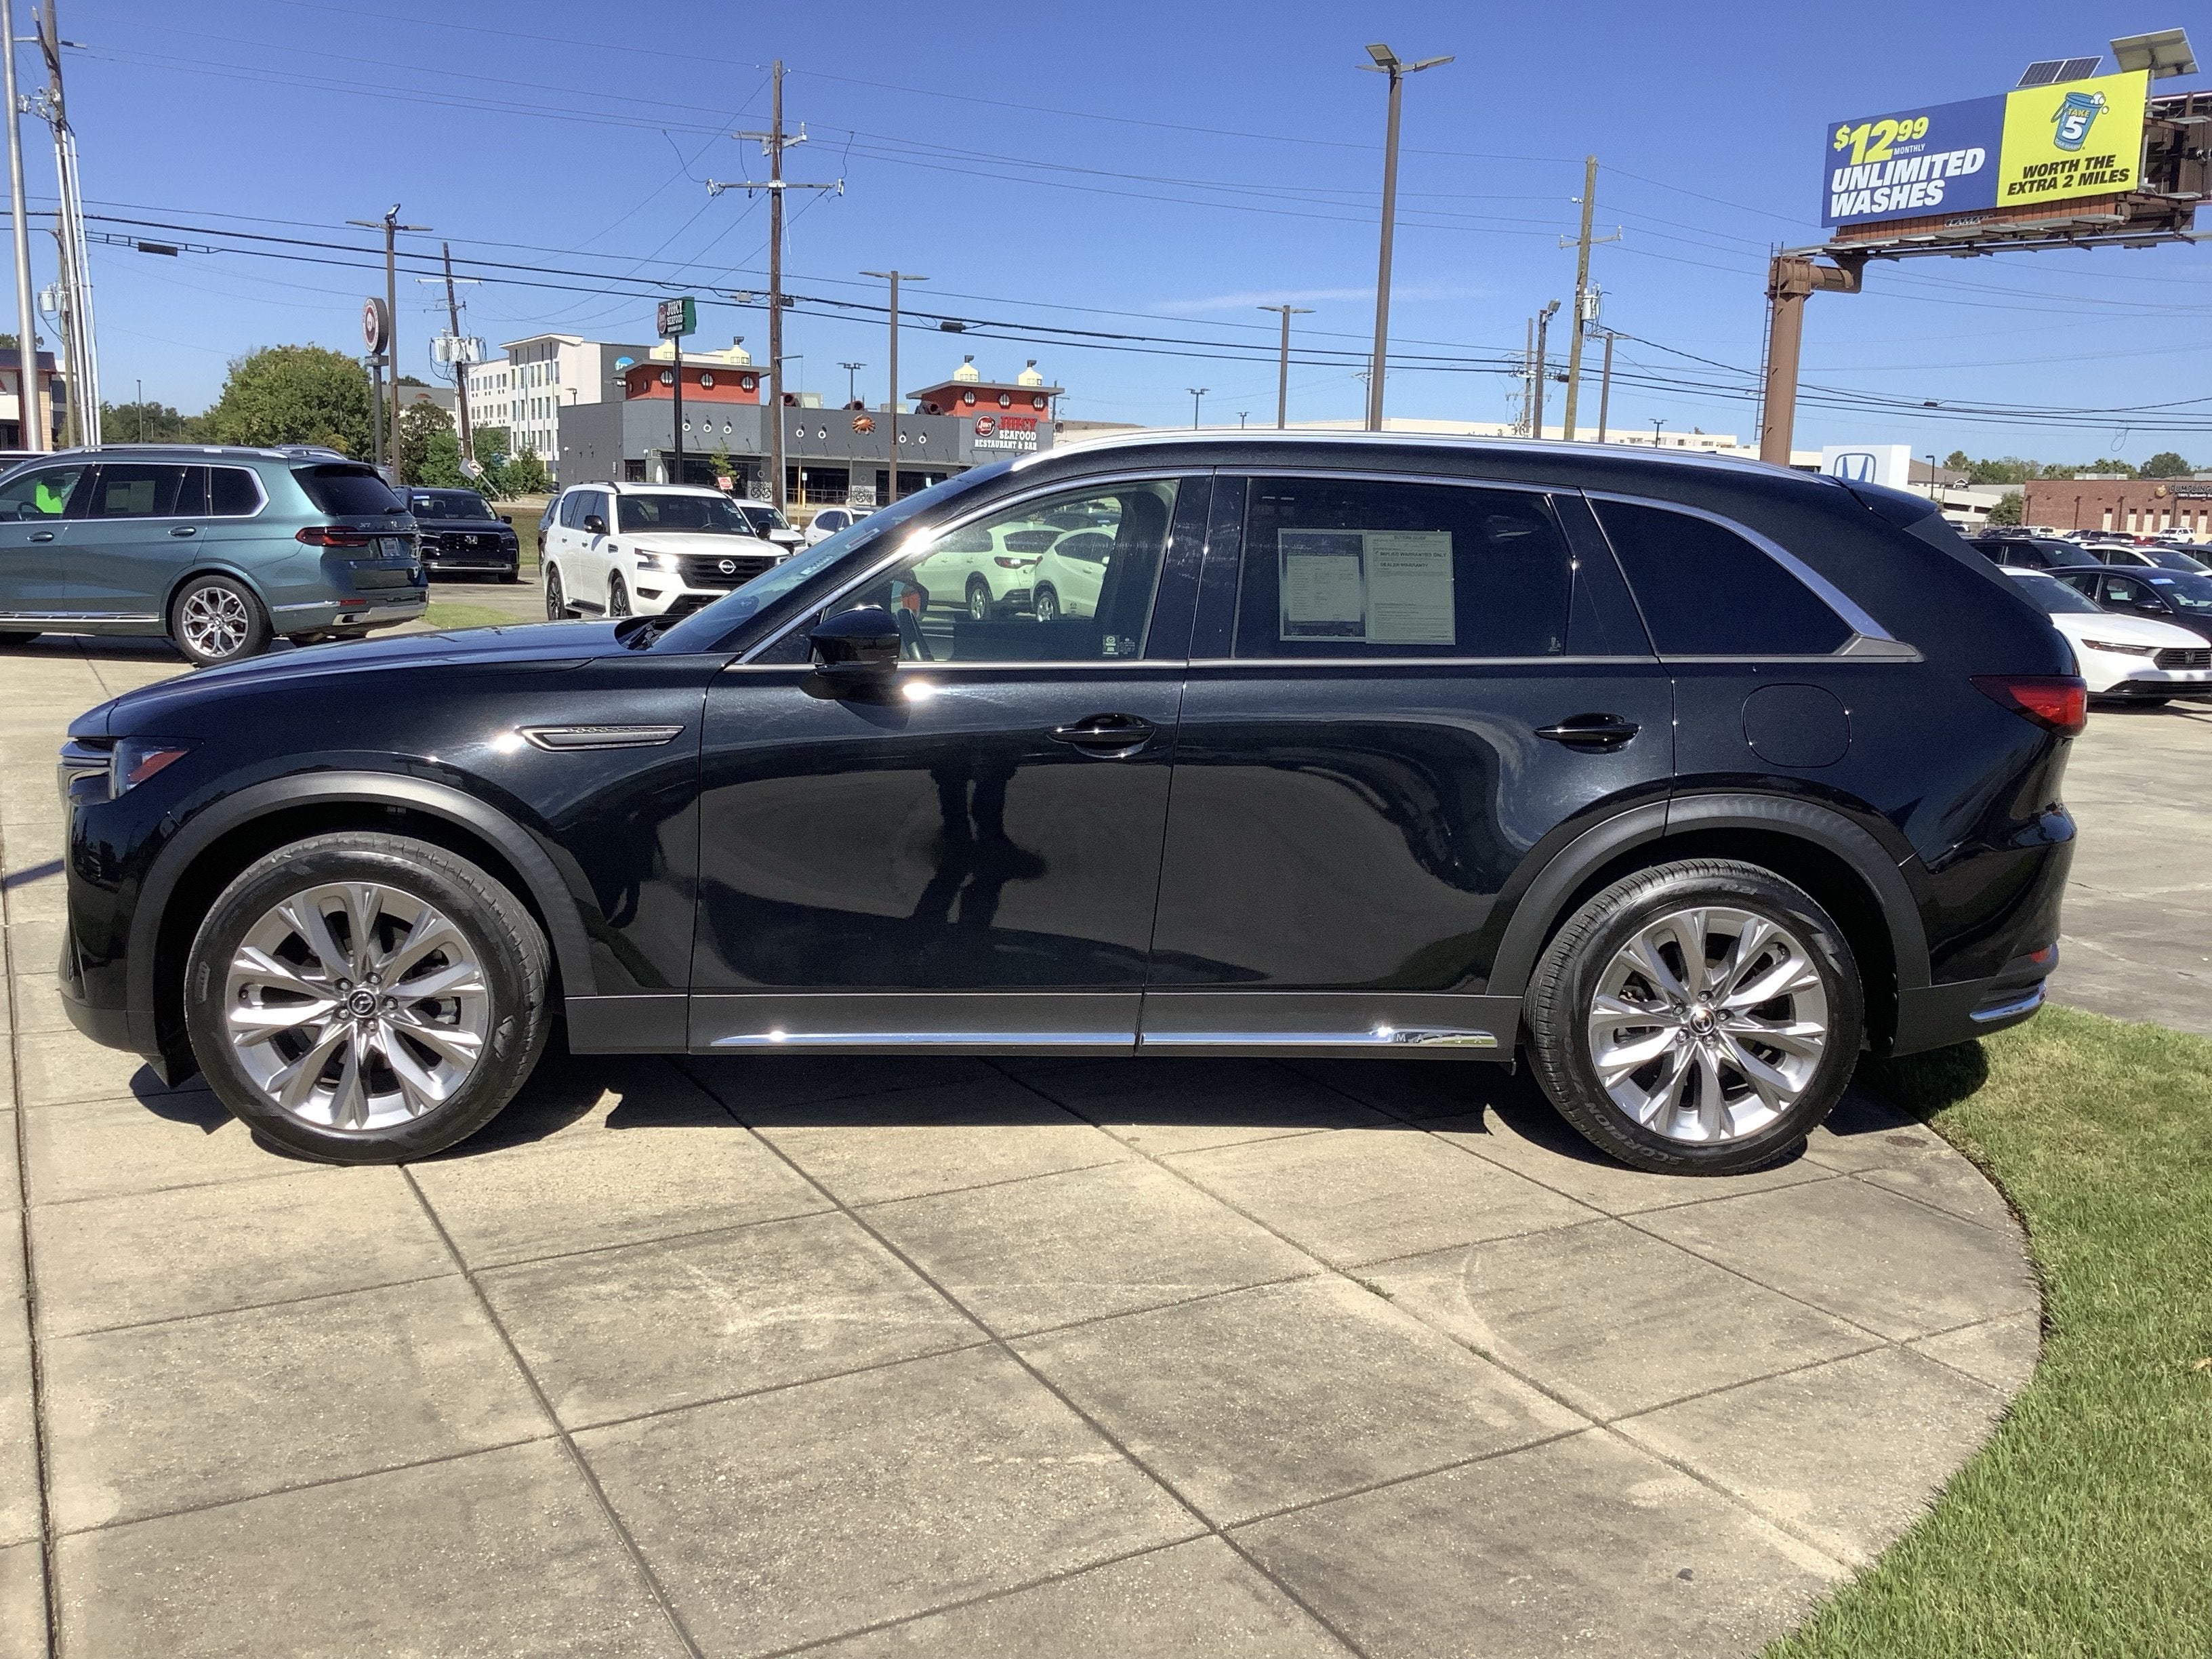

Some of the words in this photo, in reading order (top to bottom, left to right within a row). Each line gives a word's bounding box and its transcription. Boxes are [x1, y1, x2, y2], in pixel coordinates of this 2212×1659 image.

[2068, 108, 2091, 118] TAKE
[2062, 115, 2087, 140] 5
[1893, 143, 1926, 156] MONTHLY
[1831, 147, 1986, 193] UNLIMITED
[2022, 158, 2081, 180] WORTH
[2085, 154, 2116, 170] THE
[2007, 176, 2058, 196] EXTRA
[2062, 174, 2074, 188] 2
[2077, 168, 2131, 186] MILES
[1830, 179, 1946, 218] WASHES
[667, 300, 683, 316] JUICY
[997, 415, 1038, 431] JUICY
[975, 439, 1017, 449] RESTAURANT
[1018, 441, 1023, 450] &
[1024, 442, 1038, 451] BAR
[999, 430, 1037, 441] SEAFOOD
[1584, 1102, 1685, 1165] SCORPION
